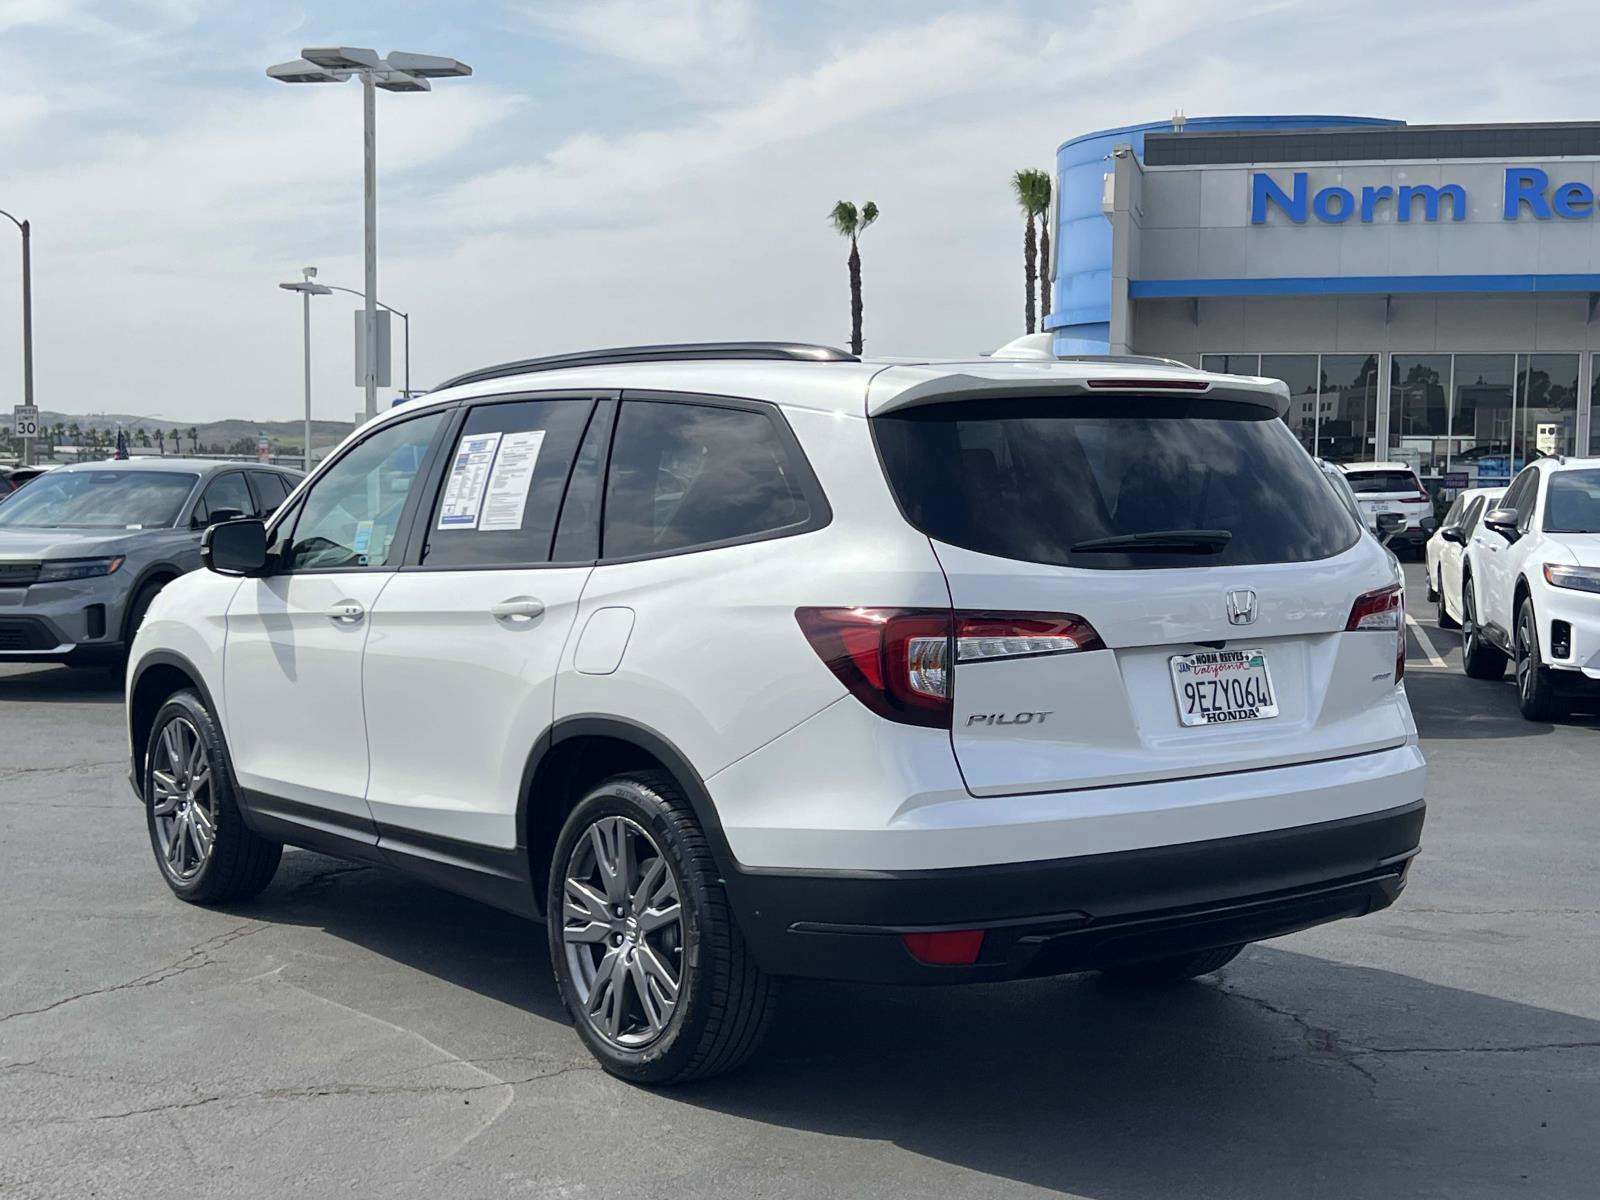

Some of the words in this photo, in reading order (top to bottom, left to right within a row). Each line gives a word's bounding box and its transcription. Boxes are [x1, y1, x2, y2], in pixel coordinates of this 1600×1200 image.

[1251, 172, 1467, 224] Norm
[1503, 167, 1600, 221] Re
[17, 422, 36, 434] 30
[1195, 653, 1218, 665] NORM
[1219, 651, 1244, 663] REEVES
[1194, 661, 1249, 677] California
[1184, 676, 1267, 714] 9EZY064
[966, 711, 1054, 726] PILOT
[1206, 708, 1258, 723] HONDA
